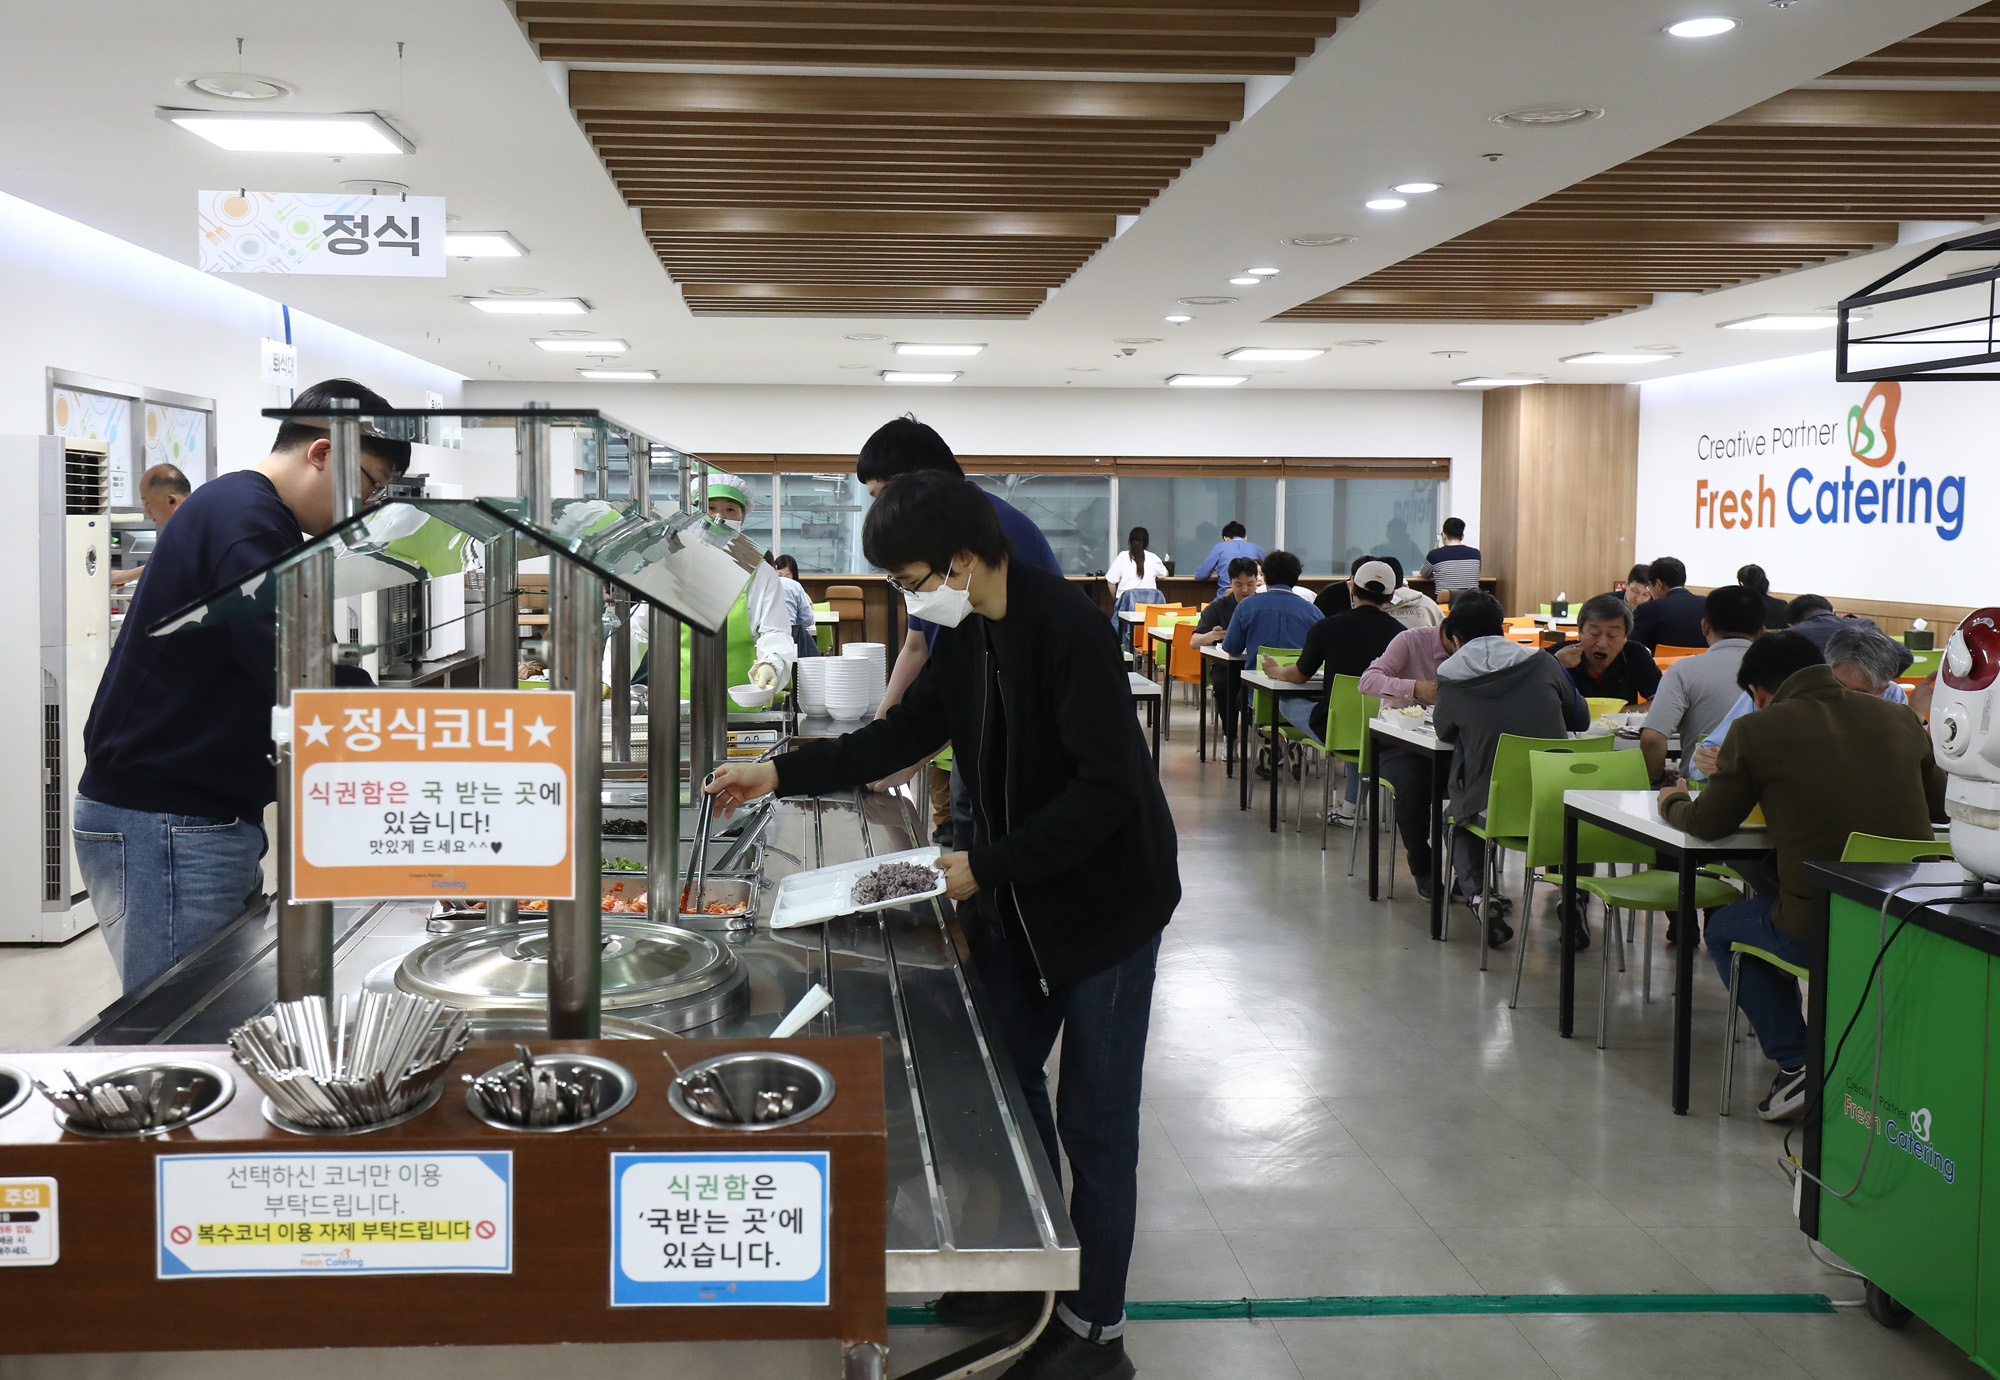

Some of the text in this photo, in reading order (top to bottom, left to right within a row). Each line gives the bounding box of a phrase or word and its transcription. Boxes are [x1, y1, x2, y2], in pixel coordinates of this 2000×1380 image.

[322, 214, 420, 257] 정식
[1697, 420, 1838, 461] Creative Partner
[1695, 460, 1966, 541] Fresh Catering
[342, 707, 514, 752] 정식코너
[308, 781, 562, 806] 식권함은 국 받는 곳에
[384, 811, 491, 835] 있습니다!
[369, 839, 415, 855] 맛있게
[1845, 1077, 1908, 1120] Creativ Partner
[1886, 1119, 1955, 1184] Catering
[227, 1163, 442, 1189] 선택하신 코너만 이용
[667, 1174, 777, 1201] 식권함은
[5, 1187, 40, 1206] 주의
[264, 1193, 406, 1218] 부탁드립니다.
[199, 1220, 472, 1243] 복수코너 이용 자제 부탁드립니다
[325, 1258, 364, 1268] Catering
[663, 1241, 781, 1269] 있습니다.
